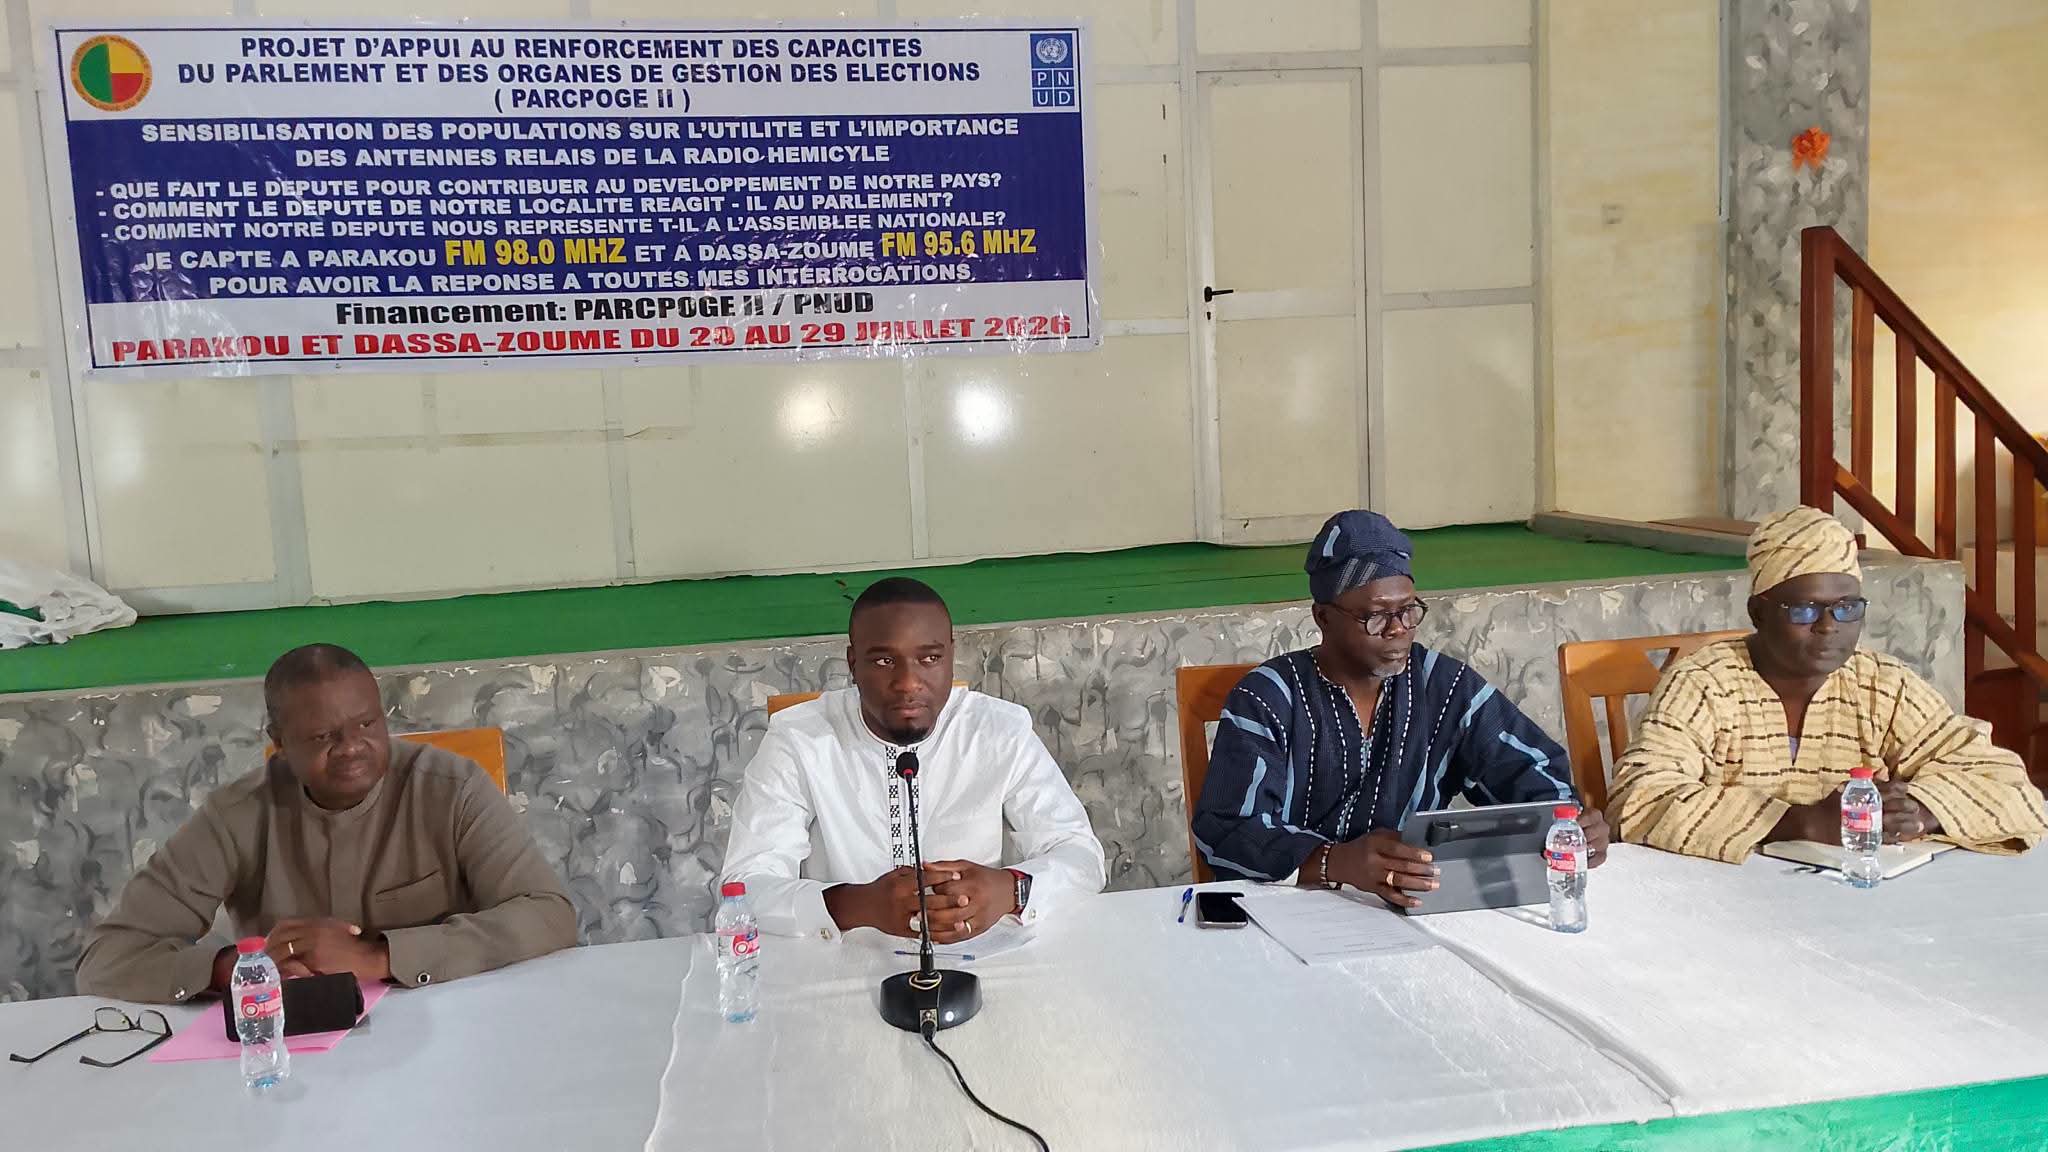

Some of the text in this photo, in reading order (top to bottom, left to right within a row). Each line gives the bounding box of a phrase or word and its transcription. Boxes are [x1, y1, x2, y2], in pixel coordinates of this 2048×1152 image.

[241, 37, 922, 58] PROJET D'APPUI AU RENFORCEMENT DES CAPACITES
[178, 62, 980, 83] DU PARLEMENT ET DES ORGANES DE GESTION DES ELECTIONS
[511, 88, 648, 108] PARCPOGE
[657, 88, 673, 108] II
[142, 118, 1018, 141] SENSIBILISATION DES POPULATIONS SUR L'UTILITE ET L'IMPORTANCE
[295, 145, 889, 166] DES ANTENNES RELAIS DE LA RADIO HEMICYLE
[110, 181, 159, 199] QUE
[167, 181, 220, 197] FAIT
[228, 181, 257, 196] LE
[265, 180, 359, 197] DEPUTE
[365, 179, 432, 195] POUR
[438, 179, 589, 194] CONTRIBUER
[595, 178, 625, 193] AU
[633, 176, 822, 192] DEVELOPPEMENT
[828, 175, 856, 189] DE
[863, 174, 934, 191] NOTRE
[940, 172, 1001, 193] PAYS?
[113, 201, 239, 218] COMMENT
[247, 200, 278, 216] LE
[285, 199, 383, 216] DEPUTE
[390, 199, 422, 215] DE
[429, 198, 511, 214] NOTRE
[519, 197, 633, 213] LOCALITE
[640, 196, 725, 212] REAGIT
[746, 195, 767, 210] IL
[773, 194, 804, 210] AU
[811, 192, 953, 209] PARLEMENT?
[114, 222, 236, 241] COMMENT
[243, 221, 325, 237] NOTRE
[331, 221, 425, 236] DEPUTE
[432, 220, 498, 235] NOUS
[504, 218, 653, 234] REPRESENTE
[658, 217, 699, 232] T-IL
[702, 217, 721, 231] A
[727, 214, 873, 232] L'ASSEMBLEE
[877, 211, 1006, 231] NATIONALE?
[143, 229, 1036, 271] JE CAPTE A PARAKOU FM 98.0 MHZ ET A DASSA-ZOUME FM 95.6 MHZ
[209, 264, 971, 294] POUR AVOIR LA REPONSE A TOUTES MES INTERROGATIONS
[336, 292, 873, 324] Financement: PARCPOGE II / PNUD
[112, 315, 1071, 360] PARAKOU ET DASSA-ZOUME DU 20 AU 29 JUILLET 2026
